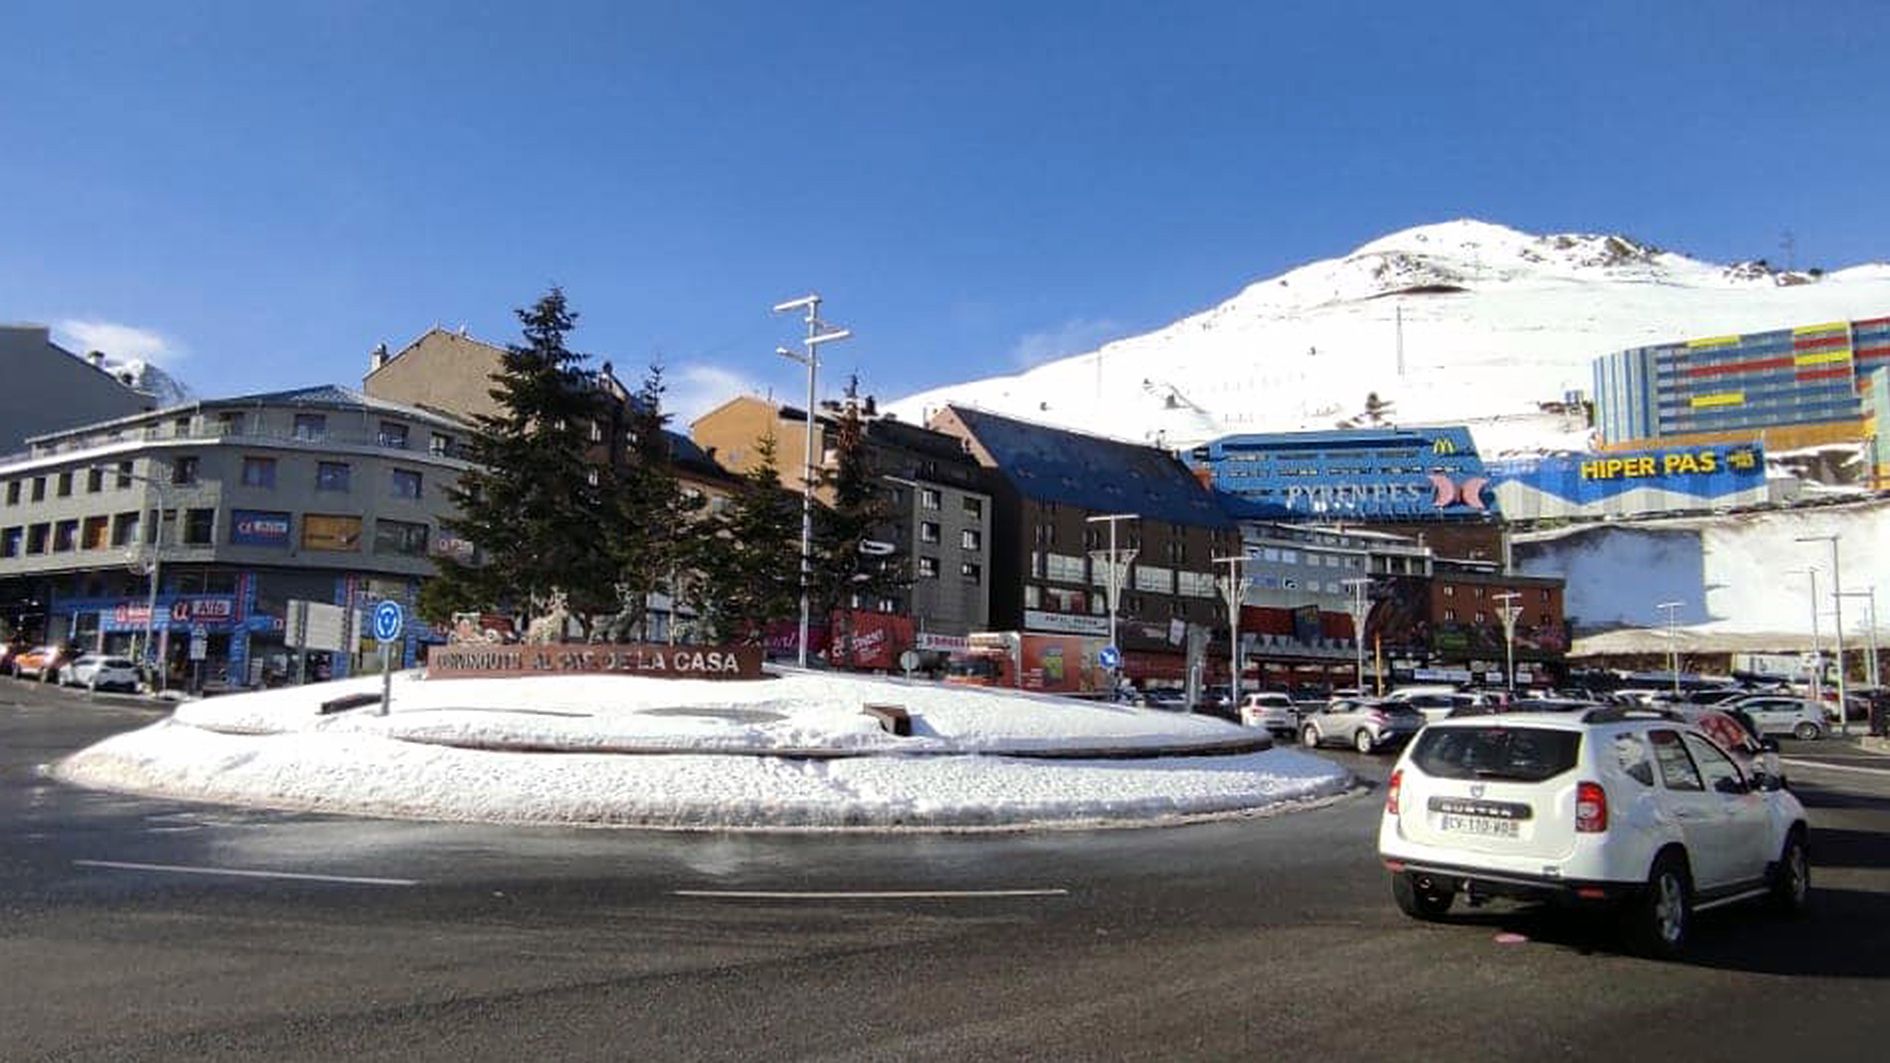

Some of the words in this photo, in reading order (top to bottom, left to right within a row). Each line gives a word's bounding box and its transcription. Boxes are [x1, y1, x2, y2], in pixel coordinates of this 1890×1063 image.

[1580, 457, 1656, 479] HIPER
[1663, 451, 1717, 474] PAS
[637, 651, 666, 670] LA
[673, 651, 739, 672] CASA
